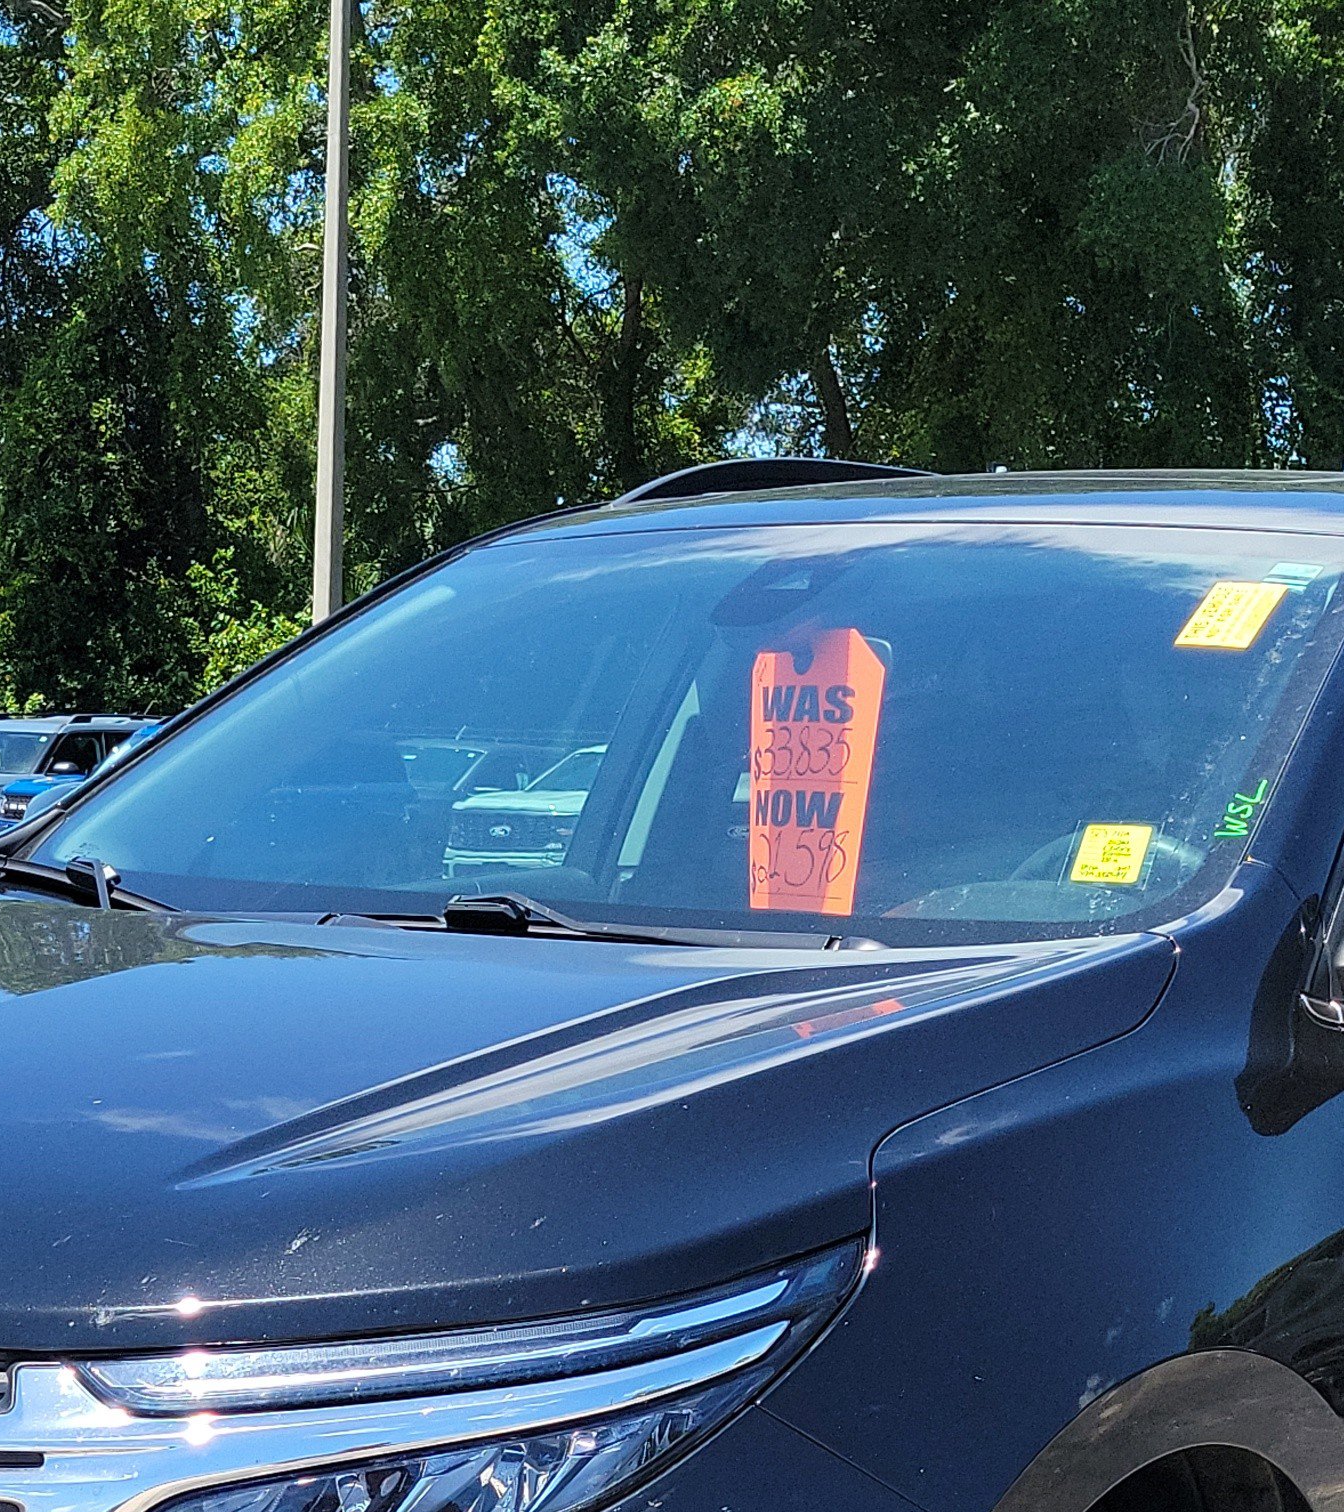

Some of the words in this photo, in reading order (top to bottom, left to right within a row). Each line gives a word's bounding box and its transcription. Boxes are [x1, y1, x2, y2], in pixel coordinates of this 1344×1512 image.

[762, 684, 856, 725] WAS
[755, 789, 844, 829] NOW
[1214, 779, 1268, 836] WSL
